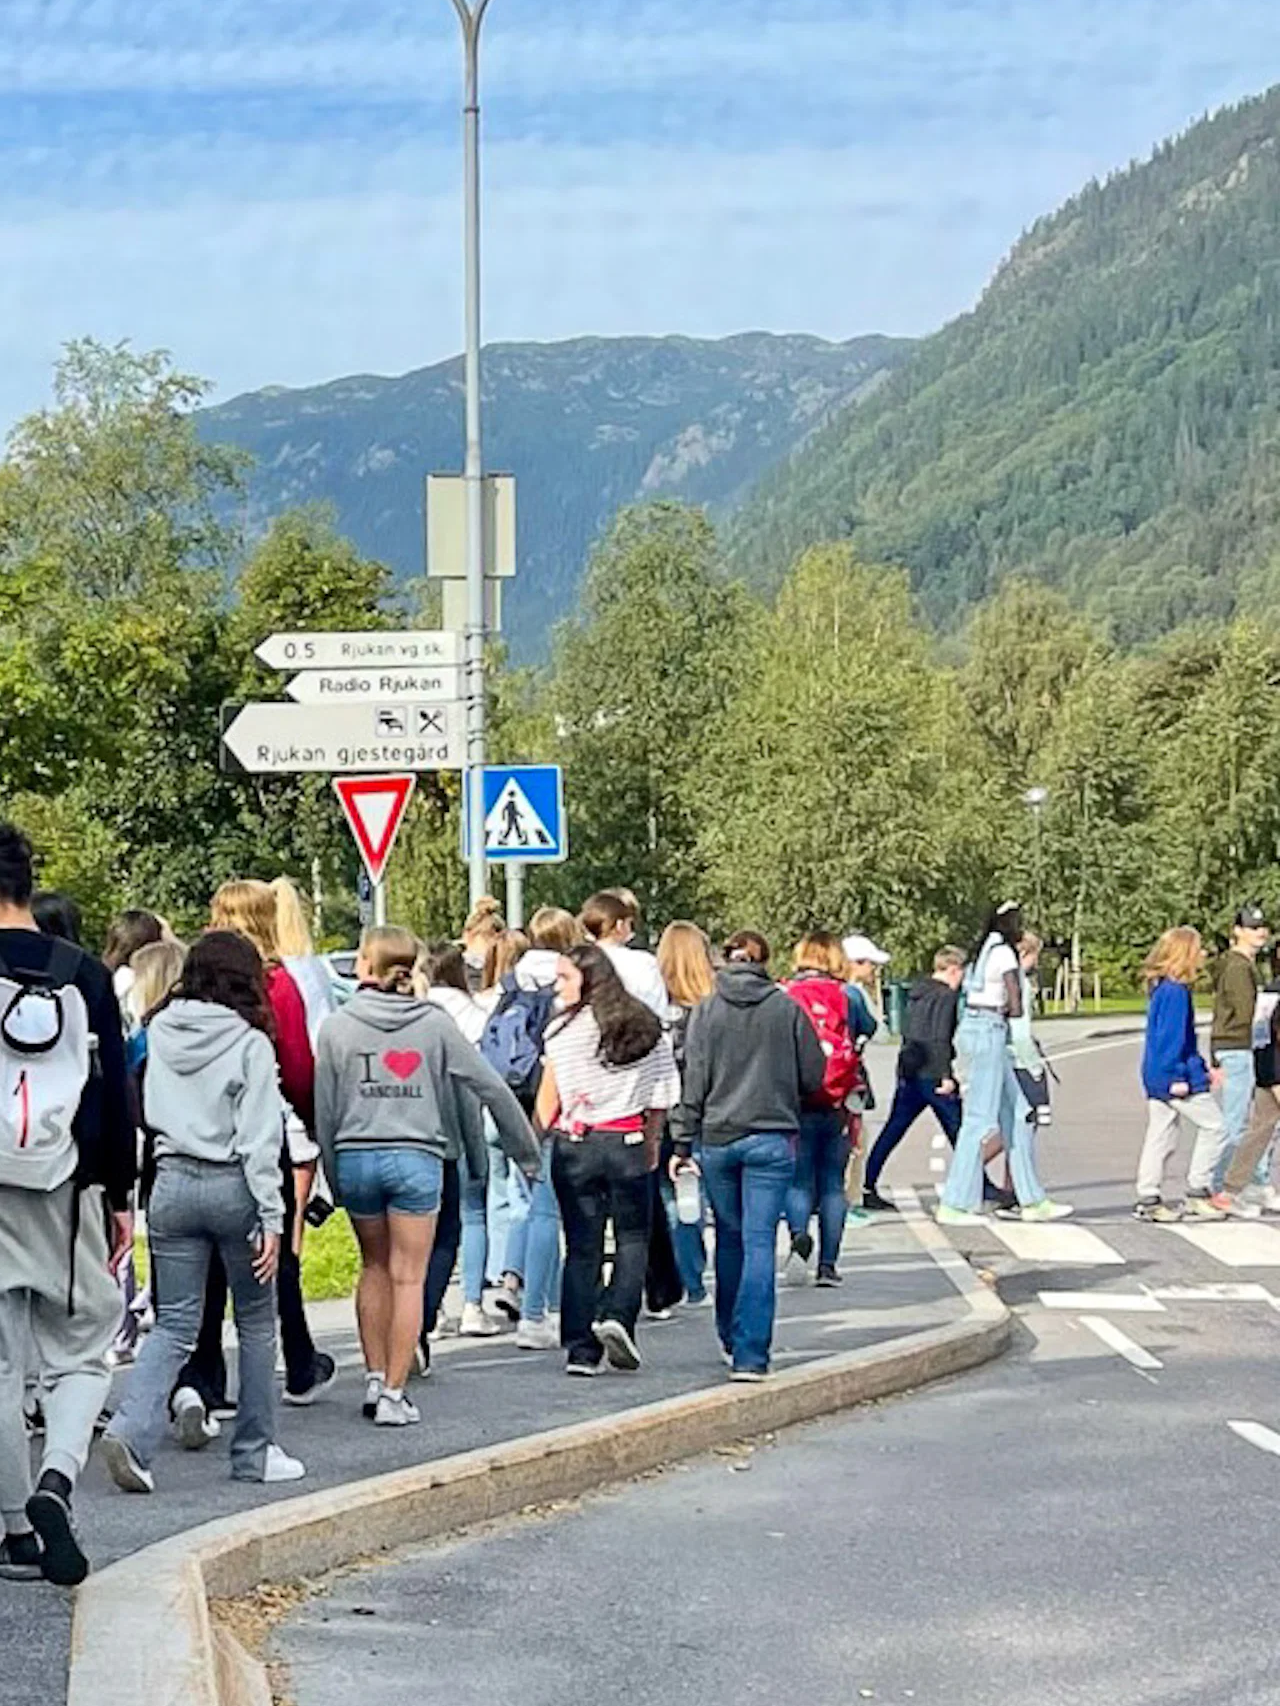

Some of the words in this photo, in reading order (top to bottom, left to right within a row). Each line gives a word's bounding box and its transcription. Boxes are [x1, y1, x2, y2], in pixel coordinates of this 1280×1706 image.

[284, 642, 316, 659] 0.5
[341, 643, 396, 660] Rjukan
[318, 677, 371, 694] Radio
[379, 675, 442, 694] Rjukan
[256, 744, 326, 767] Rjukan
[336, 742, 450, 767] gjestegård
[356, 1051, 380, 1084] I
